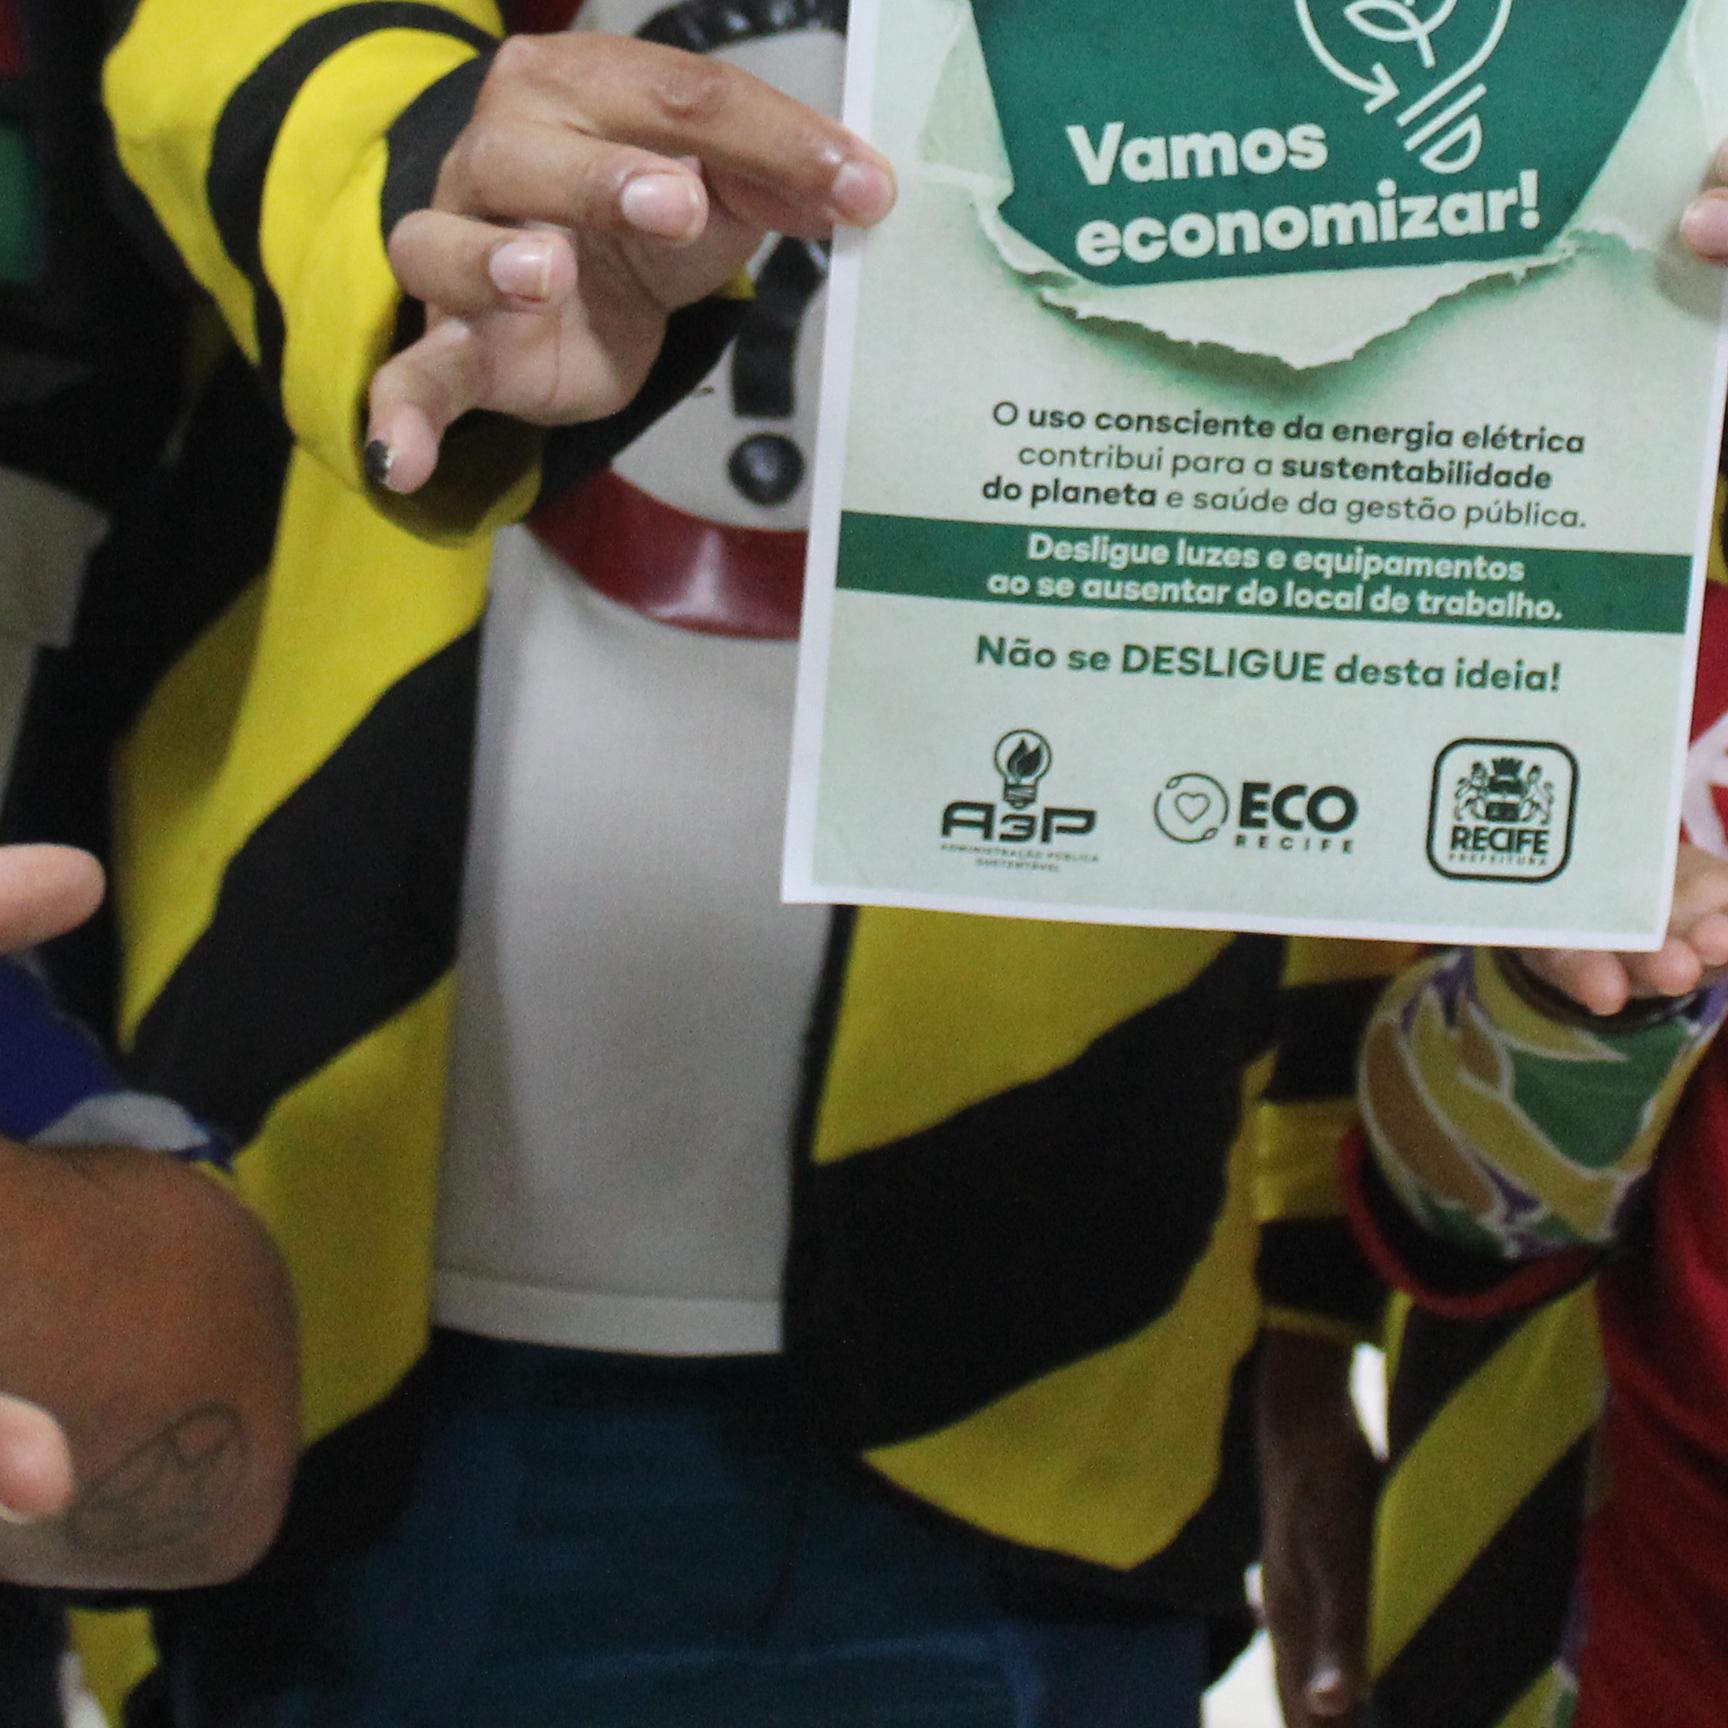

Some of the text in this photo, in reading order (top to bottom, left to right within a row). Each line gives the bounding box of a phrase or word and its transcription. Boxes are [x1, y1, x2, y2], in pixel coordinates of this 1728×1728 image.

[1065, 121, 1328, 186] Vamos
[1075, 169, 1541, 267] economizar!
[992, 401, 1586, 454] O uso consciente da energia elétrica
[1018, 445, 1553, 490] contribui para a sustentabilidade
[982, 476, 1587, 529] do planeta e saúde da gestão pública.
[1027, 532, 1525, 582] Desligue luzes e equipamentos
[987, 575, 1563, 621] ao se ausentar do local de trabalho.
[976, 634, 1561, 692] Não se DESLIGUE desta ideia!
[941, 800, 1097, 843] A3P
[1239, 782, 1359, 834] ECO
[1235, 835, 1354, 854] RECIFE
[1450, 825, 1549, 855] RECIFE
